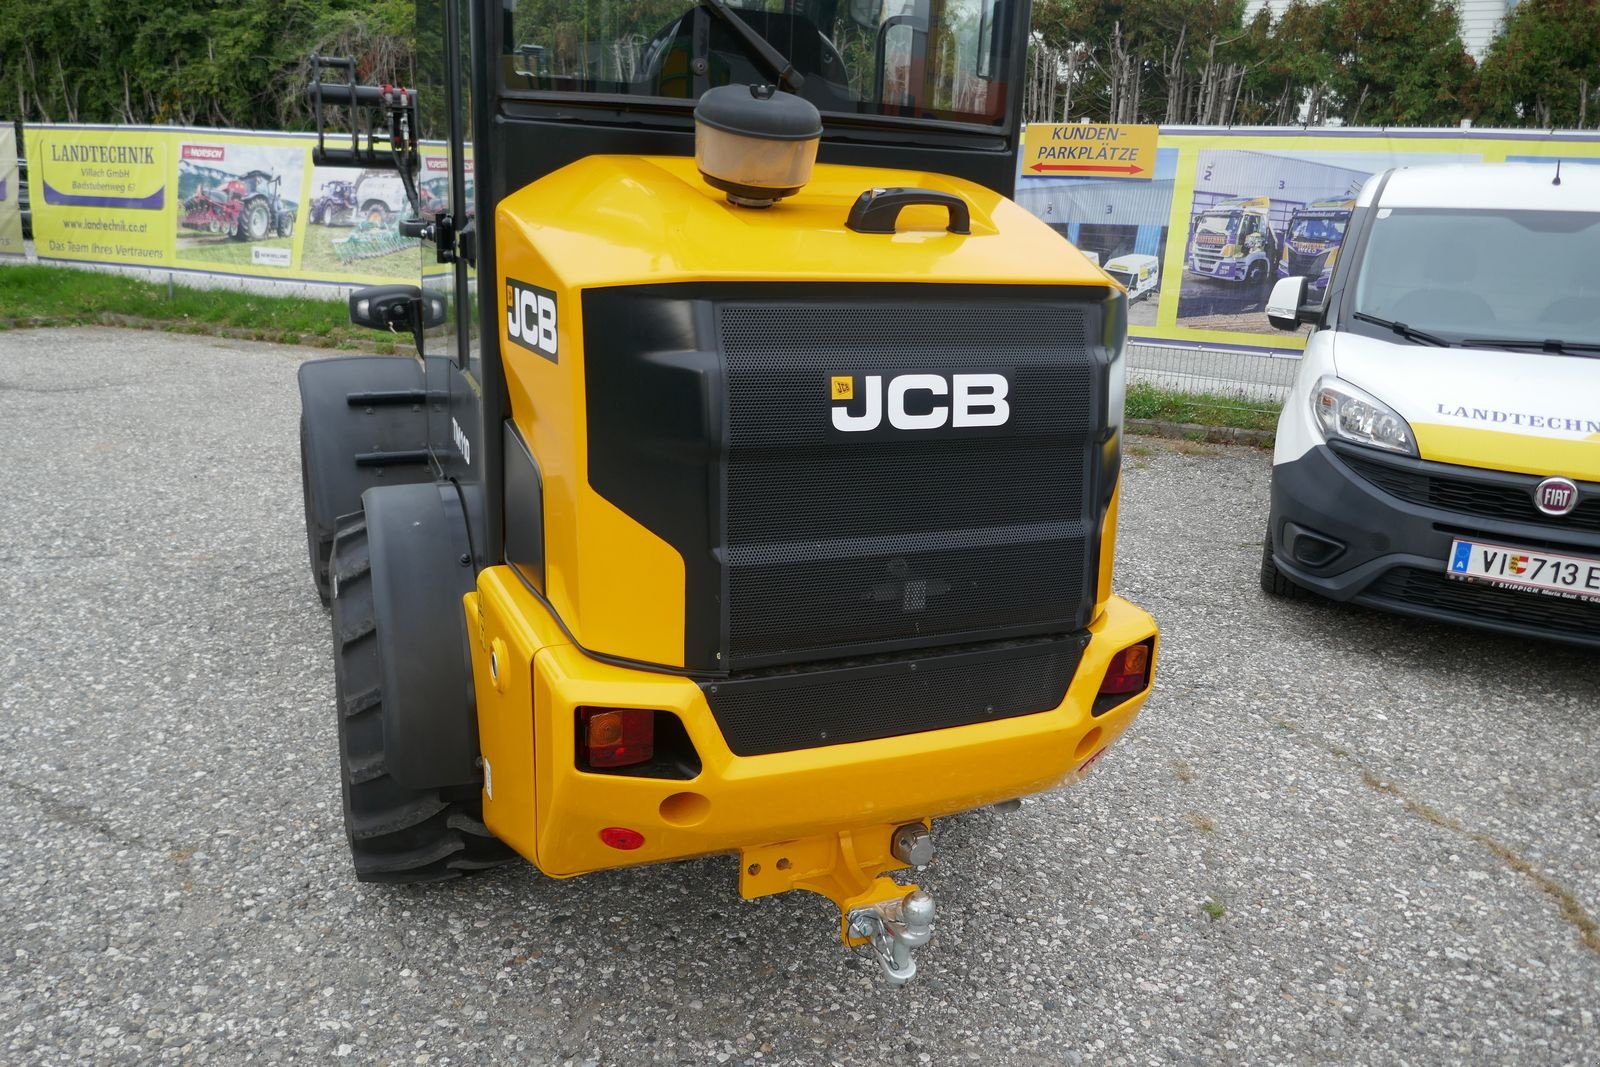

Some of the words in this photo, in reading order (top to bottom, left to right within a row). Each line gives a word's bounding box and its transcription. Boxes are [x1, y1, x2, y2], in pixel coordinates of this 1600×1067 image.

[1052, 127, 1127, 140] KUNDEN-
[51, 144, 154, 164] LANDTECHNIK
[1038, 143, 1139, 161] PARKPLÄTZE
[80, 168, 105, 177] Villach
[106, 169, 130, 177] GmbH
[1204, 170, 1212, 181] 2
[1279, 180, 1285, 190] 3
[1106, 205, 1113, 214] 3
[49, 240, 65, 251] Das
[67, 241, 89, 253] Team
[91, 243, 113, 255] Ihres
[115, 244, 164, 258] Vertrauens
[507, 286, 557, 354] JCB
[831, 374, 1010, 431] JCB
[1437, 403, 1600, 433] LANDTECHN
[1545, 488, 1570, 507] FIAT
[1484, 550, 1507, 575] VI
[1499, 583, 1539, 594] STIPPICH
